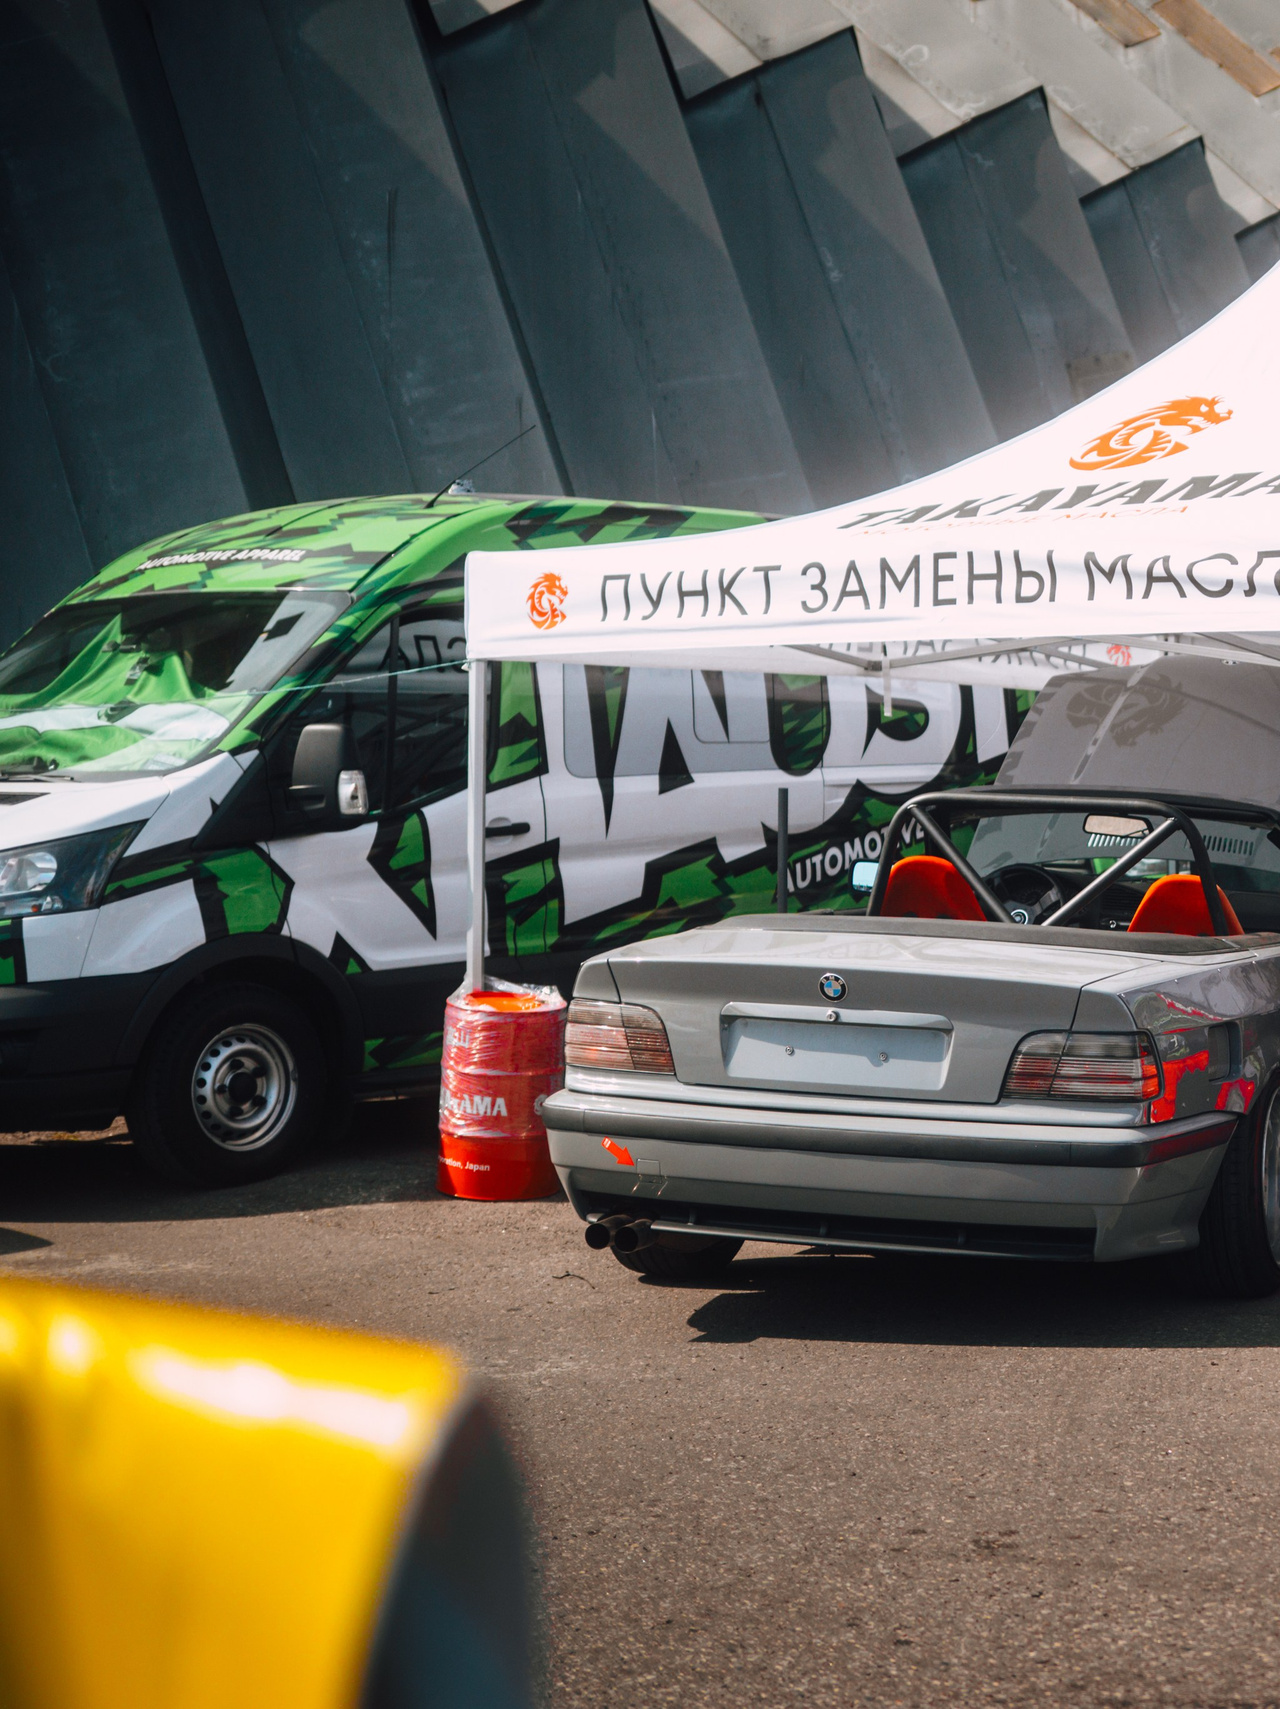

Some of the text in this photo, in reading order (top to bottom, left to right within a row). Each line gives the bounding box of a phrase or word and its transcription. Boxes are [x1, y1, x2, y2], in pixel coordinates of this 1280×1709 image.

[135, 549, 306, 571] AUTOMOTIVE APPAREL
[600, 565, 782, 622] ПУНКТ
[800, 550, 1056, 614] ЗАМЕНЫ
[465, 1161, 491, 1173] Japan
